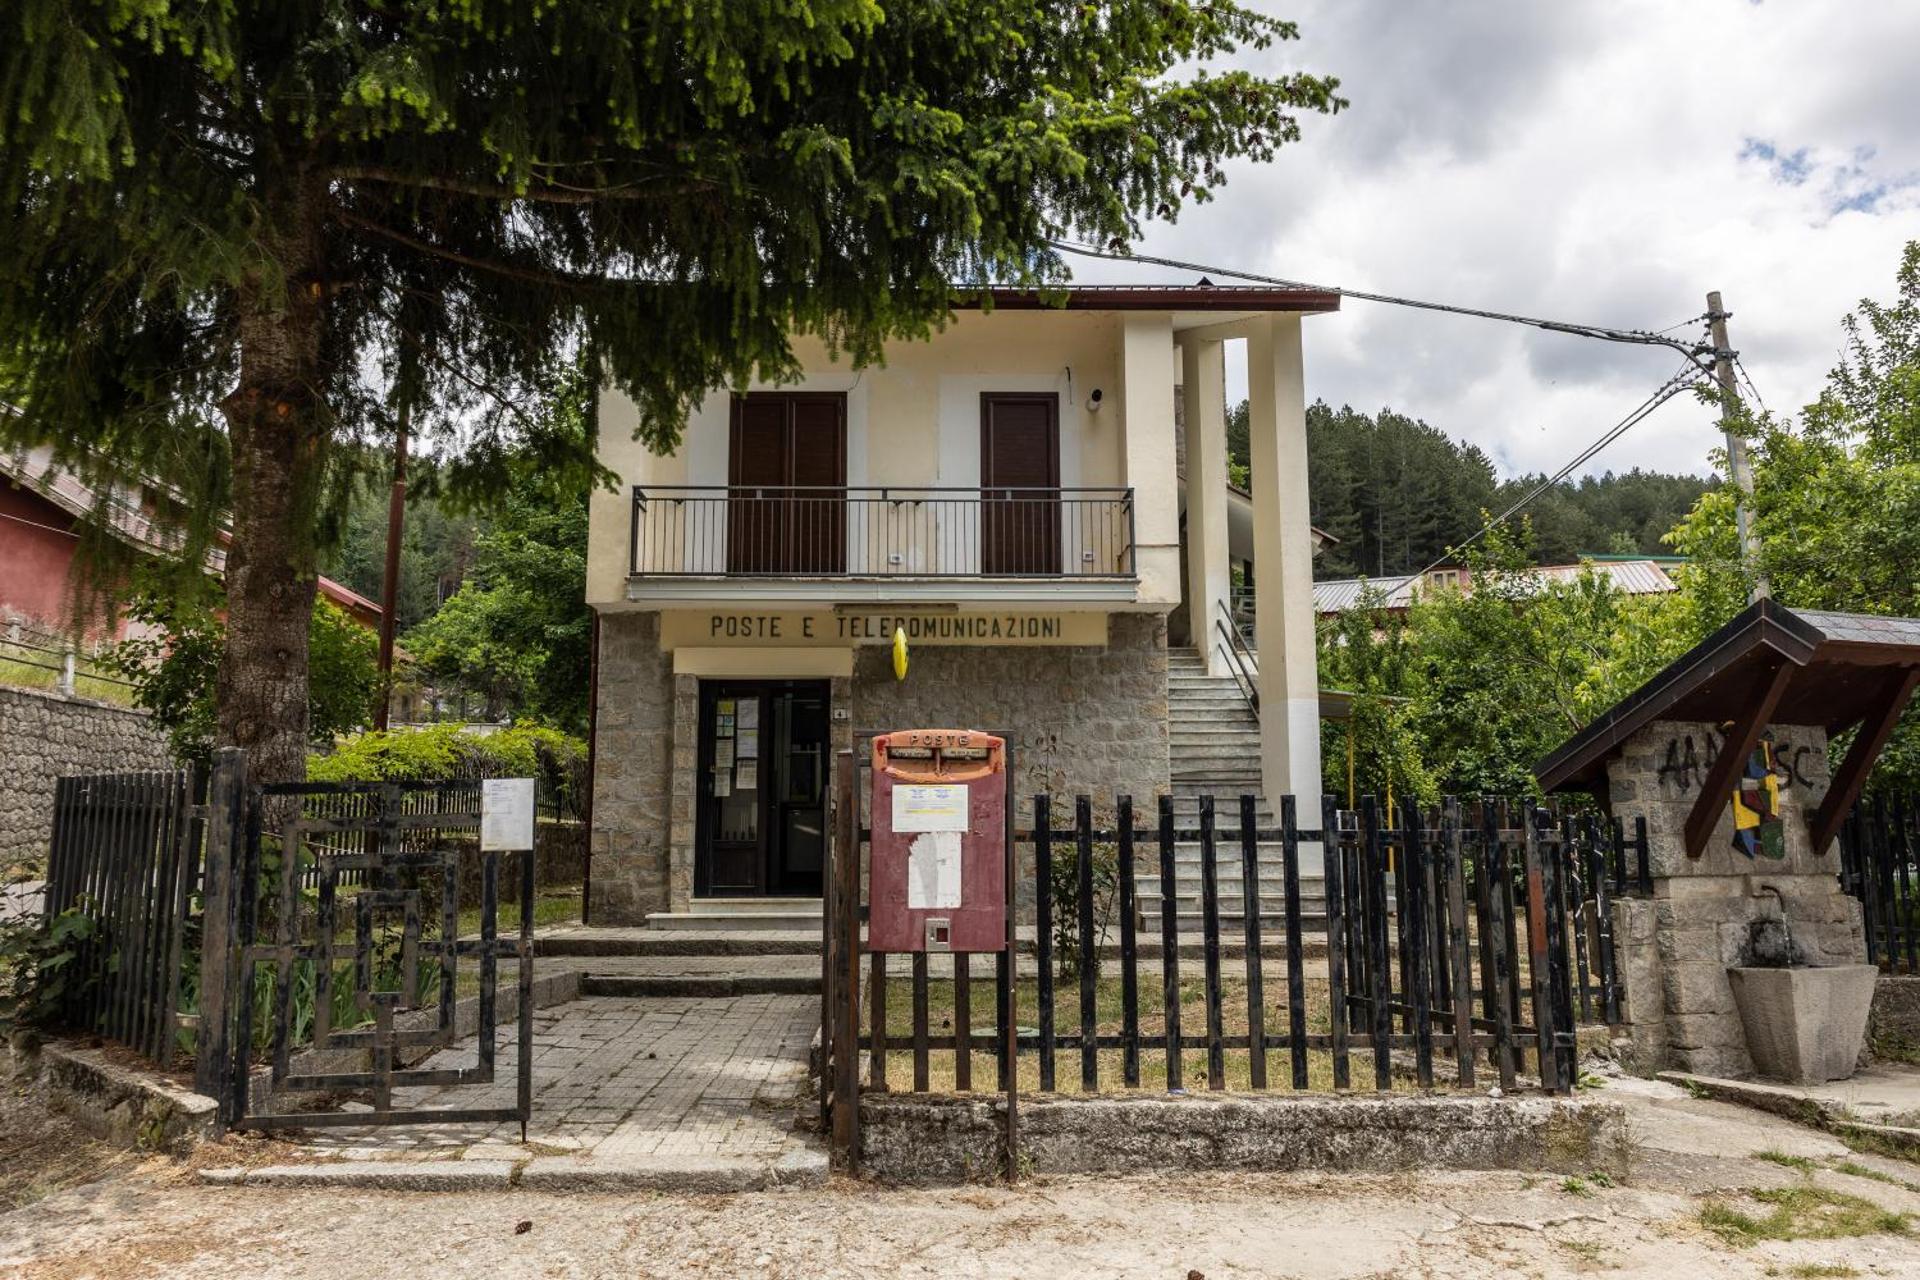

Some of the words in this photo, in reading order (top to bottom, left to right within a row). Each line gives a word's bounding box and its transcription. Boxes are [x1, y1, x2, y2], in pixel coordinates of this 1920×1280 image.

[711, 615, 782, 638] POSTE
[803, 616, 814, 638] E
[910, 735, 970, 746] POSTE
